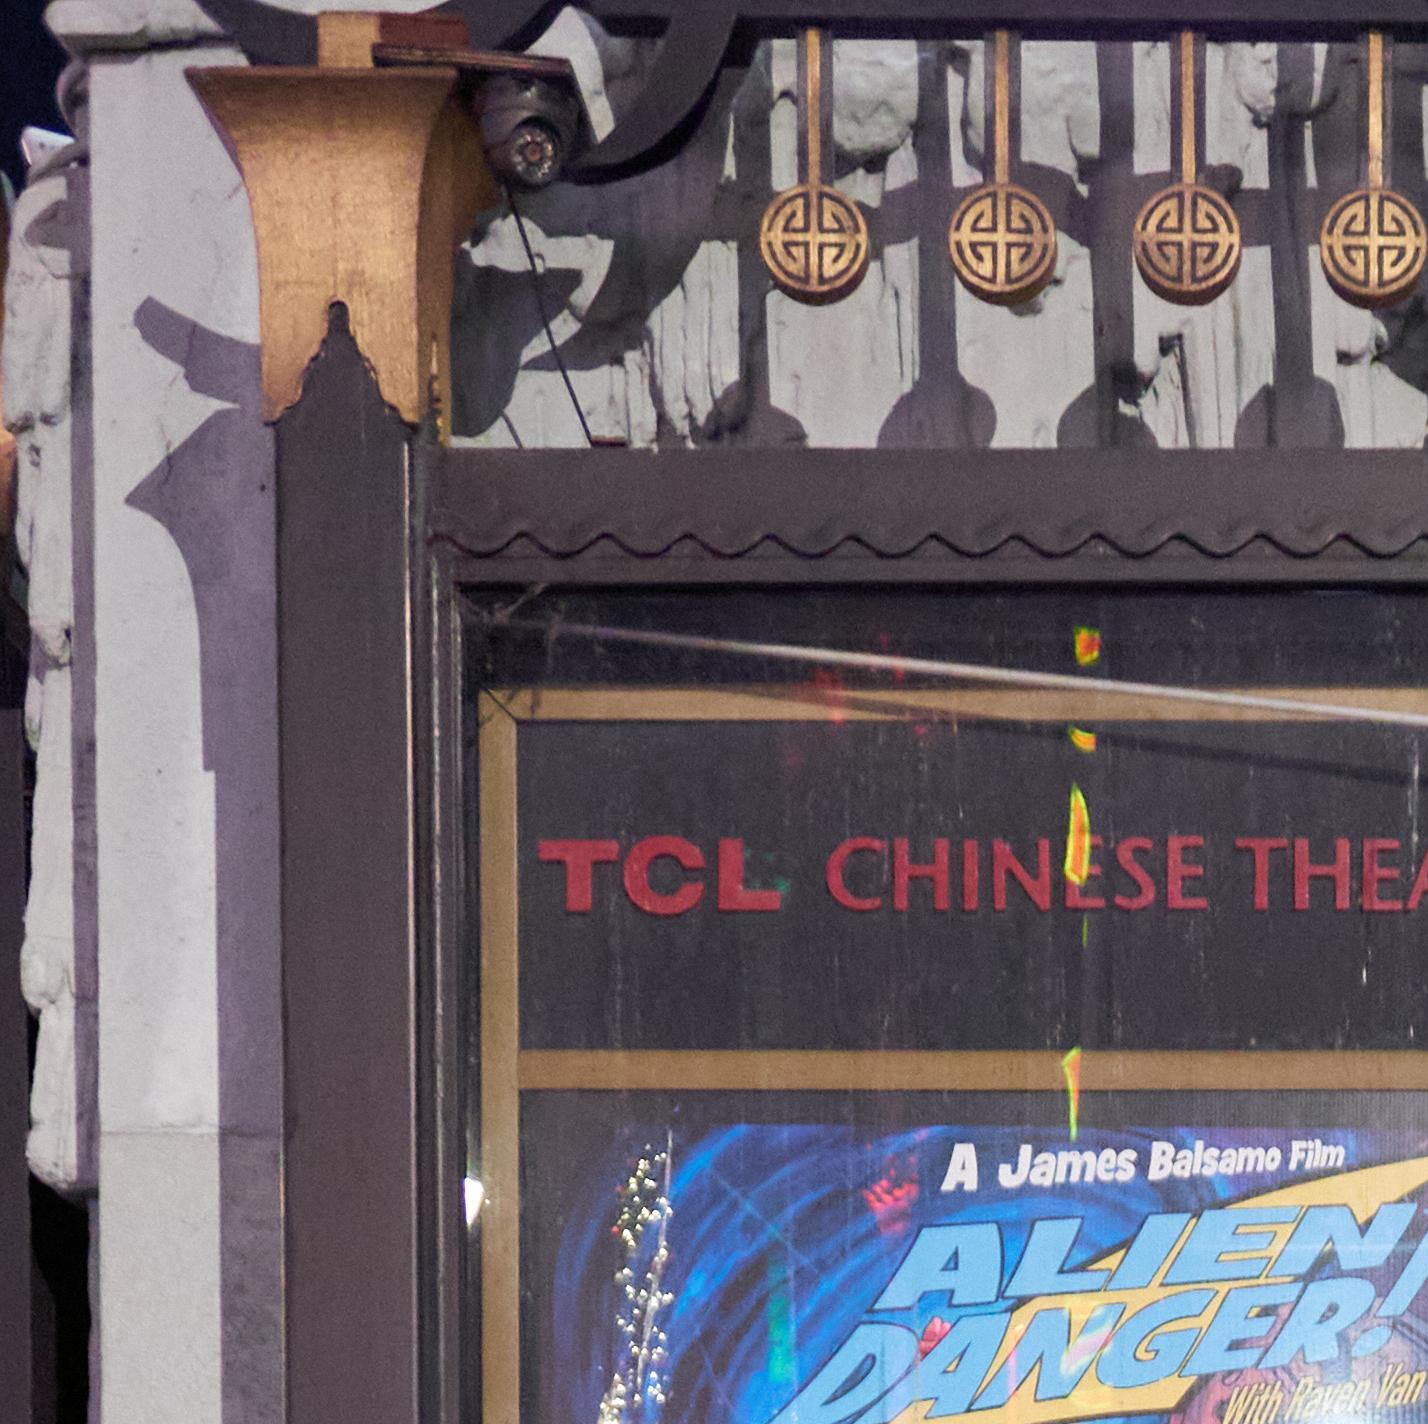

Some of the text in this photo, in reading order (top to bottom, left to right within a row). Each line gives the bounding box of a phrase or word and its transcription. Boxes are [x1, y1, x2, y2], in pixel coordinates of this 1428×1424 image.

[538, 835, 782, 915] TCL
[825, 835, 1208, 912] CHINESE
[941, 1138, 1346, 1192] A James Balsamo Film
[868, 1202, 1416, 1313] ALIEN
[1284, 1375, 1372, 1422] Raven
[1376, 1363, 1427, 1409] Van
